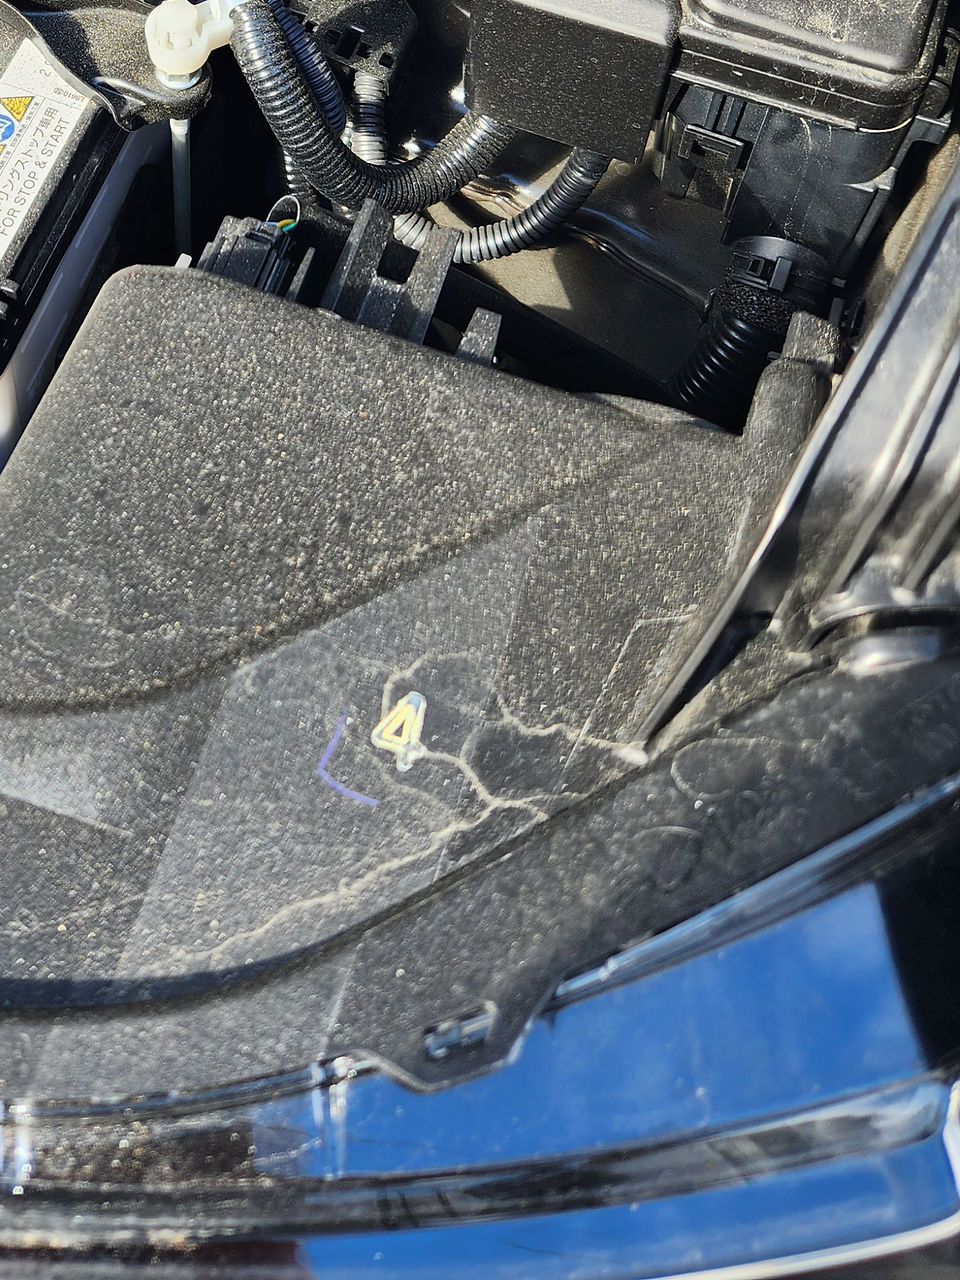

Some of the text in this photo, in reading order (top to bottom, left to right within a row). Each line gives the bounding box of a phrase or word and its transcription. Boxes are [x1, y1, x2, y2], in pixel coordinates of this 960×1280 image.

[41, 116, 70, 157] START
[35, 157, 48, 170] &
[14, 167, 42, 206] STOP
